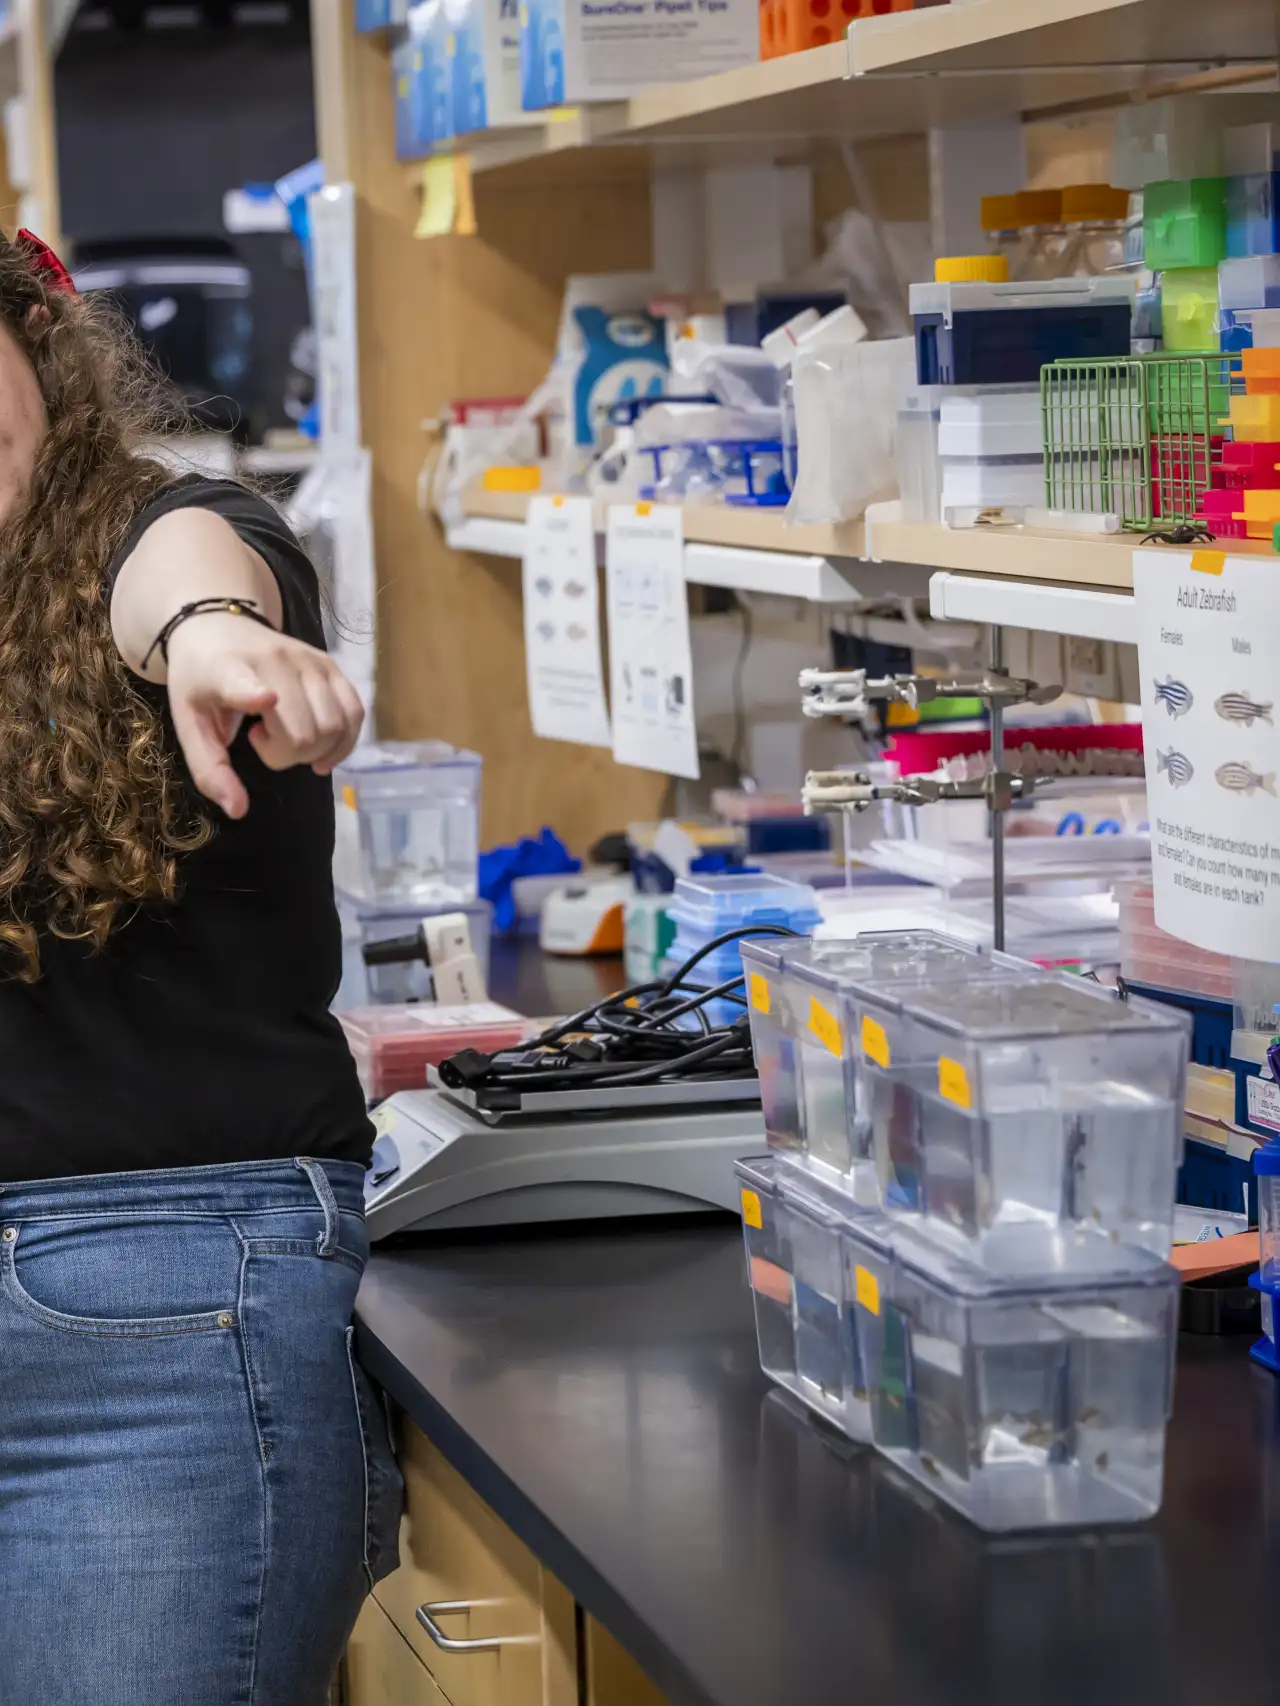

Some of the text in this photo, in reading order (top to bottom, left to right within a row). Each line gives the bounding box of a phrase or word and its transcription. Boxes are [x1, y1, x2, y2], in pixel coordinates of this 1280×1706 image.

[1177, 586, 1236, 612] Adult Zebrafish
[1160, 627, 1183, 646] Females
[1207, 832, 1258, 858] characteristics
[1260, 842, 1269, 859] of
[1207, 860, 1226, 875] count
[1227, 861, 1243, 879] how
[1245, 868, 1269, 889] many
[1203, 881, 1213, 896] are
[1221, 887, 1240, 903] each
[1241, 889, 1265, 905] tank?
